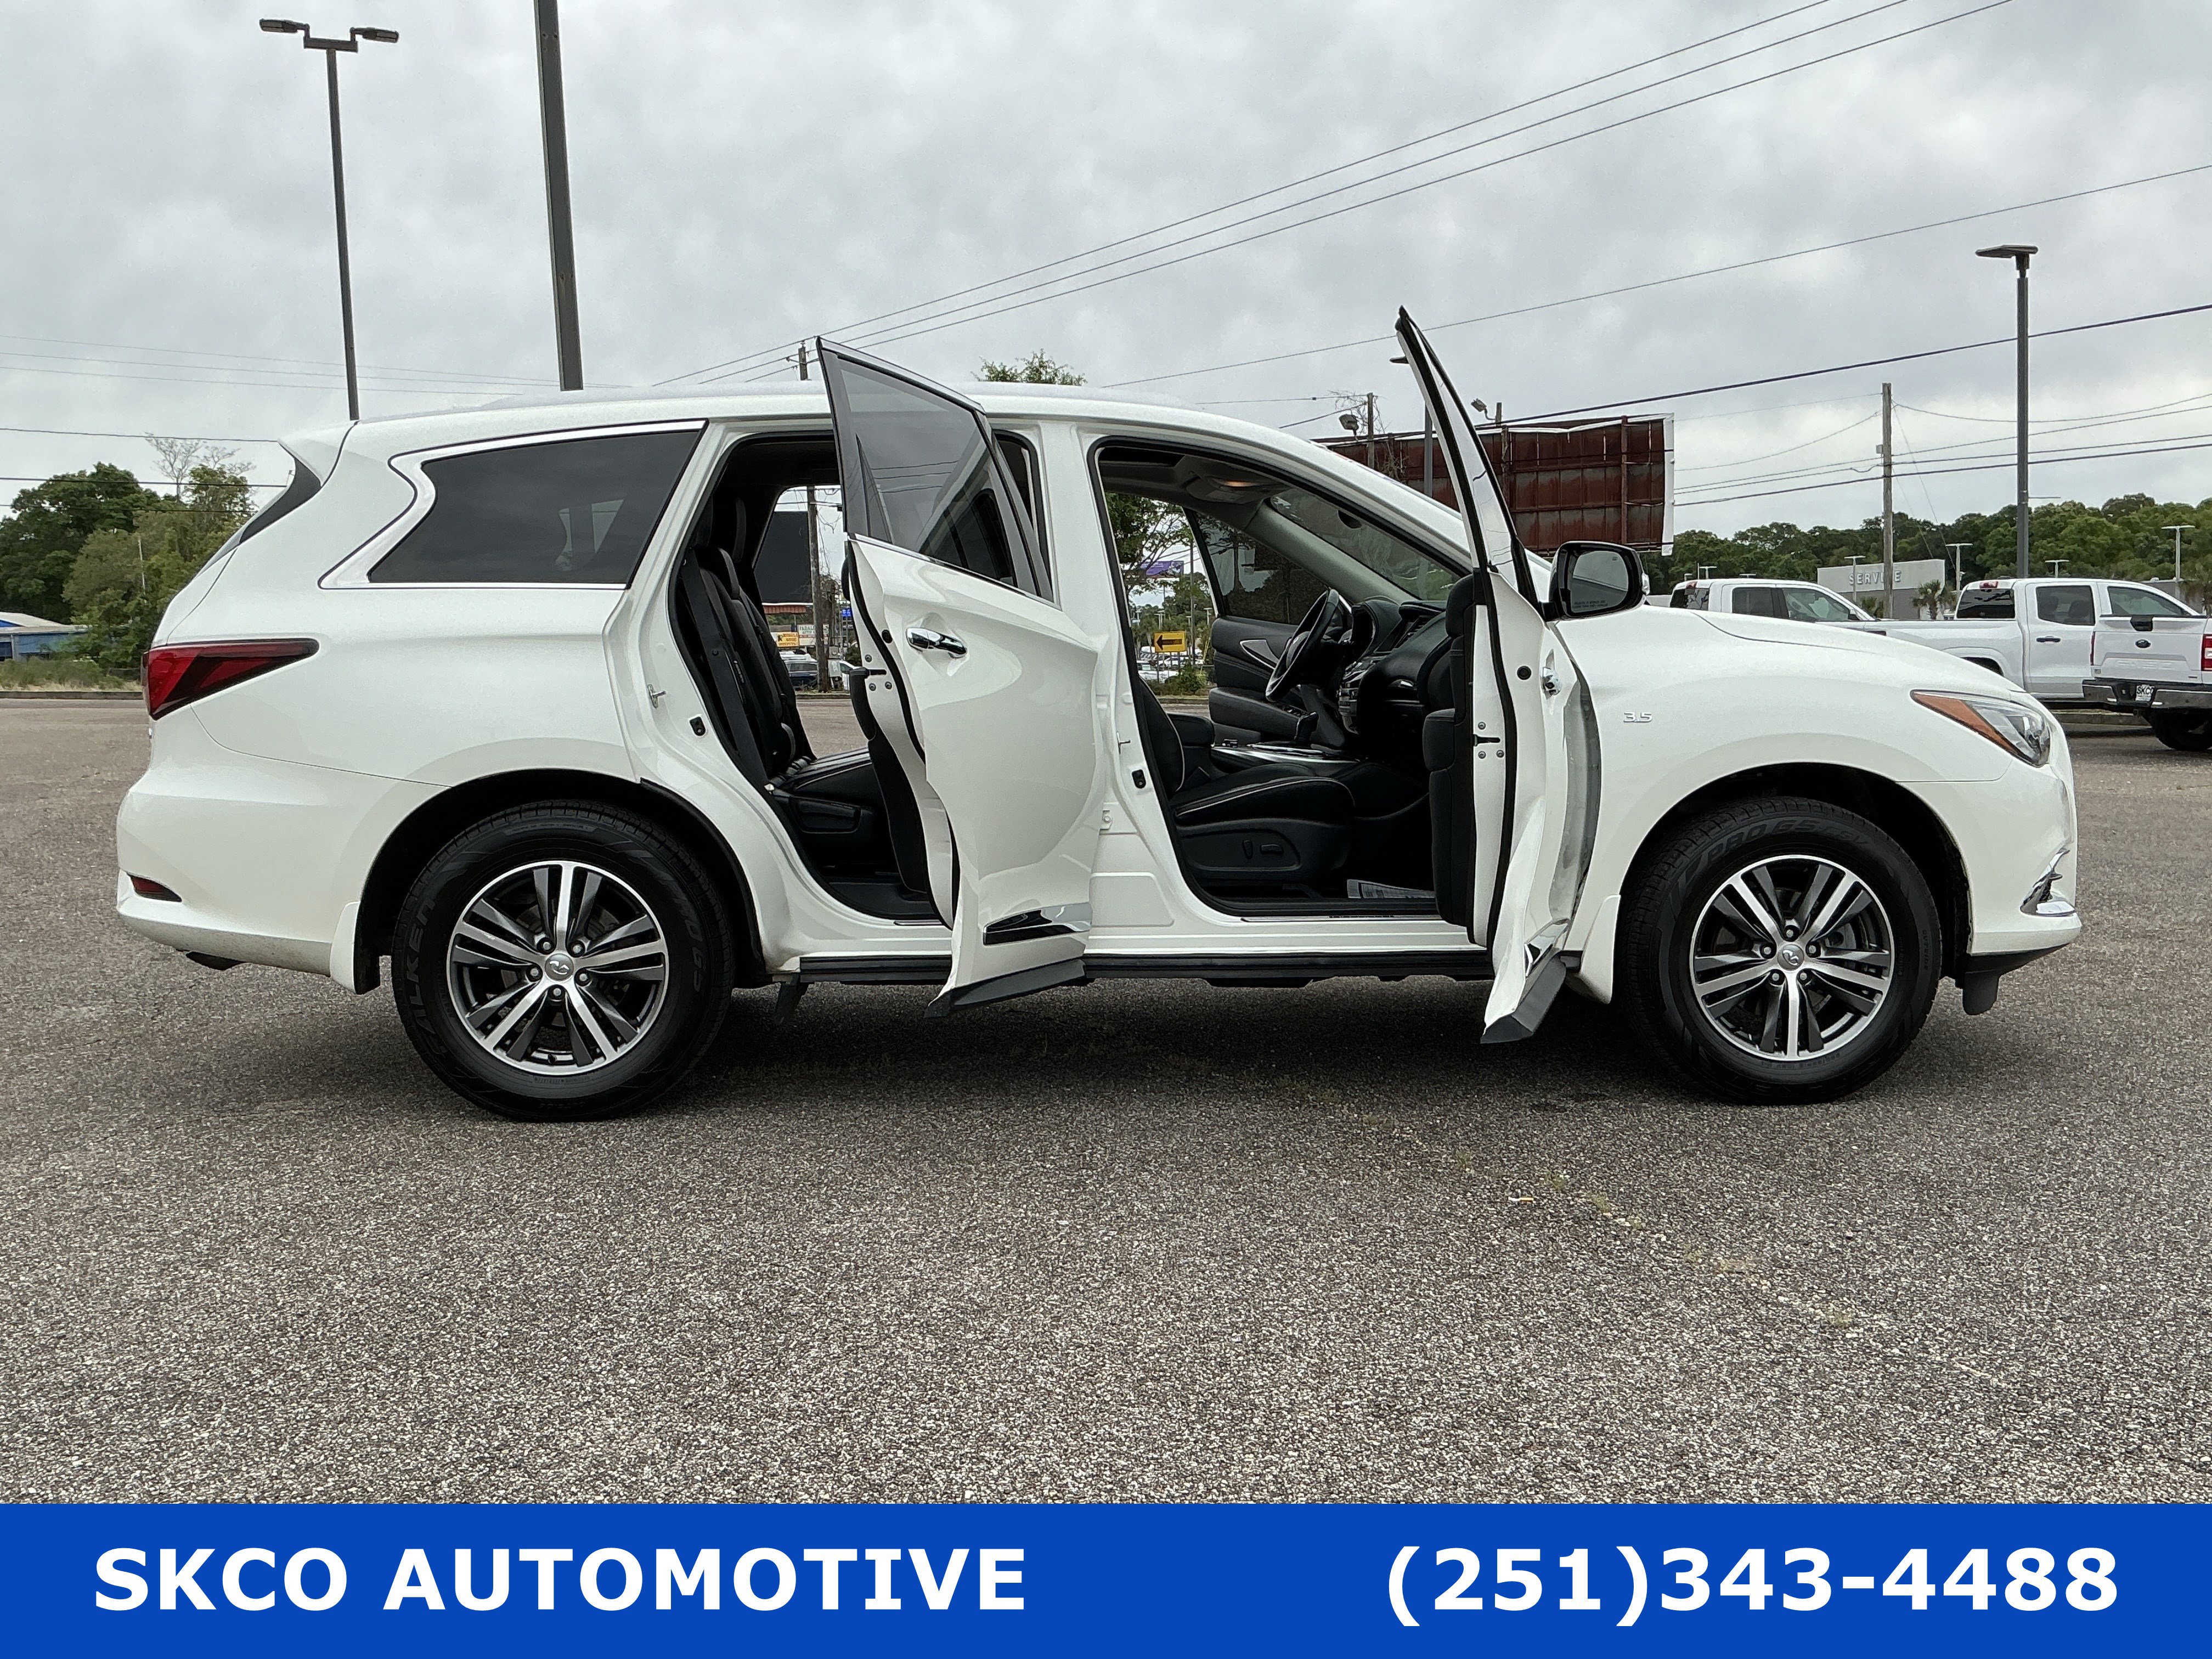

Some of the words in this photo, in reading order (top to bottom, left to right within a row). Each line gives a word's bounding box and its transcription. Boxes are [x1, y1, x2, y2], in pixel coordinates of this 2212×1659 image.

[1849, 570, 1901, 585] SERVIE
[1623, 712, 1652, 723] 3.5
[1707, 824, 1767, 862] PRO
